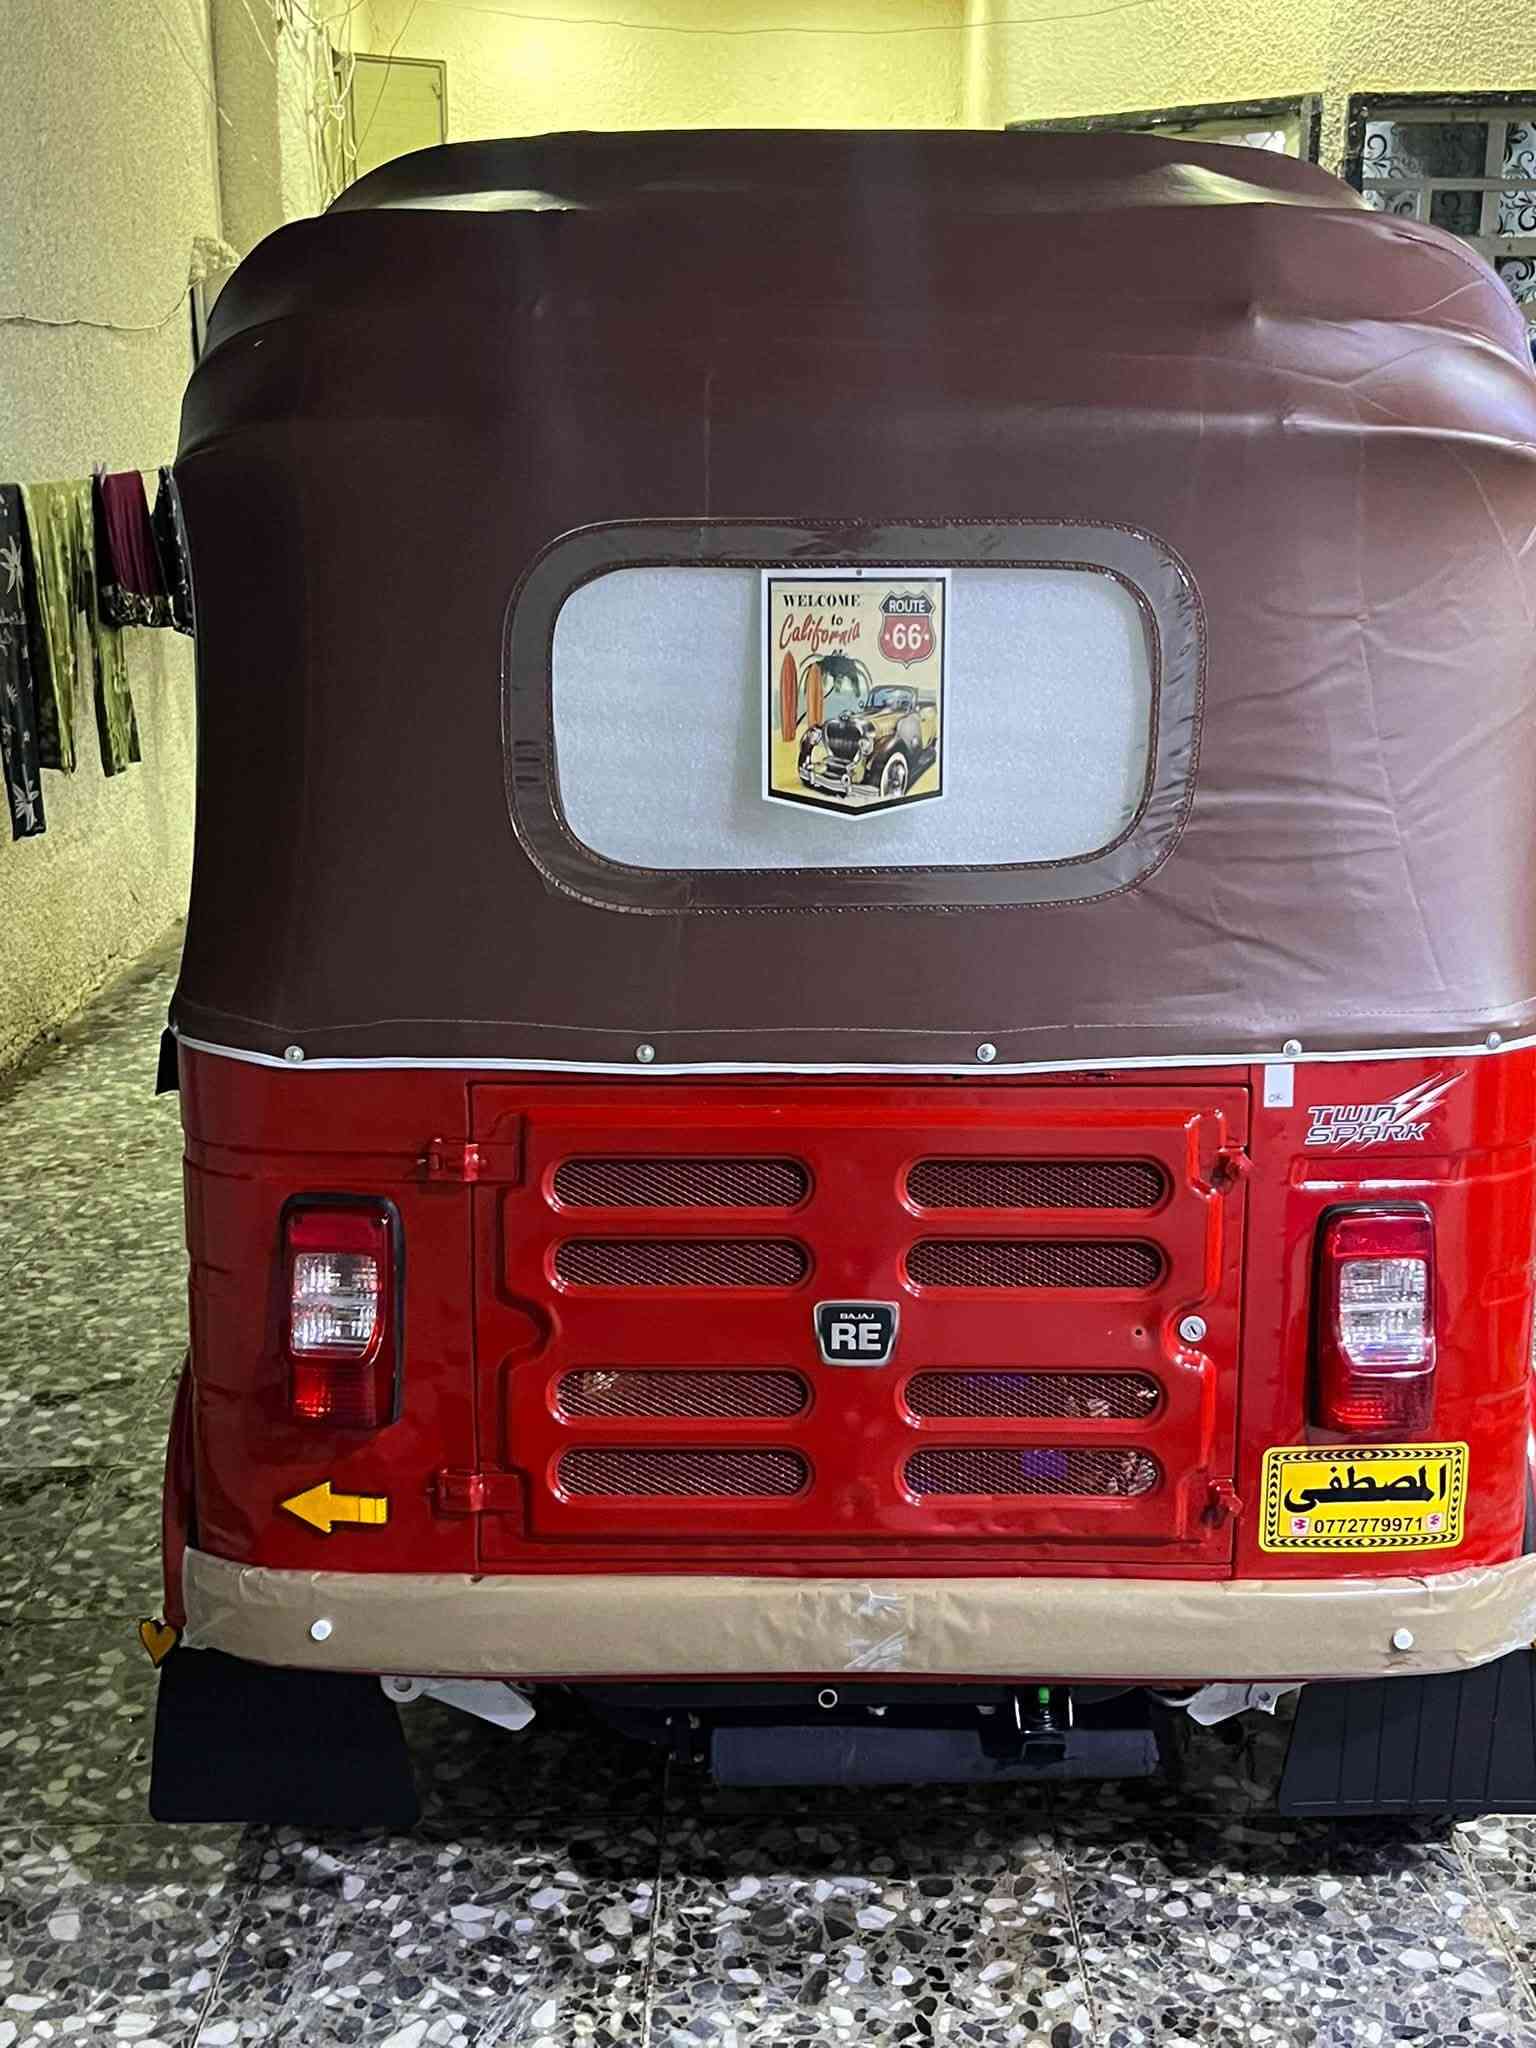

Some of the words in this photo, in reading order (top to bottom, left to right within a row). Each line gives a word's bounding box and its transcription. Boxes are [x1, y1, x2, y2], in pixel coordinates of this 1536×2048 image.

[783, 594, 861, 607] WELCOME
[889, 598, 926, 614] ROUTE
[831, 613, 844, 626] to
[779, 612, 861, 652] California
[1304, 1122, 1432, 1146] SPARK
[840, 1312, 875, 1320] BAJAJ
[831, 1322, 882, 1350] RE
[1284, 1465, 1447, 1514] المصطفى
[1314, 1517, 1423, 1534] 0772779971
